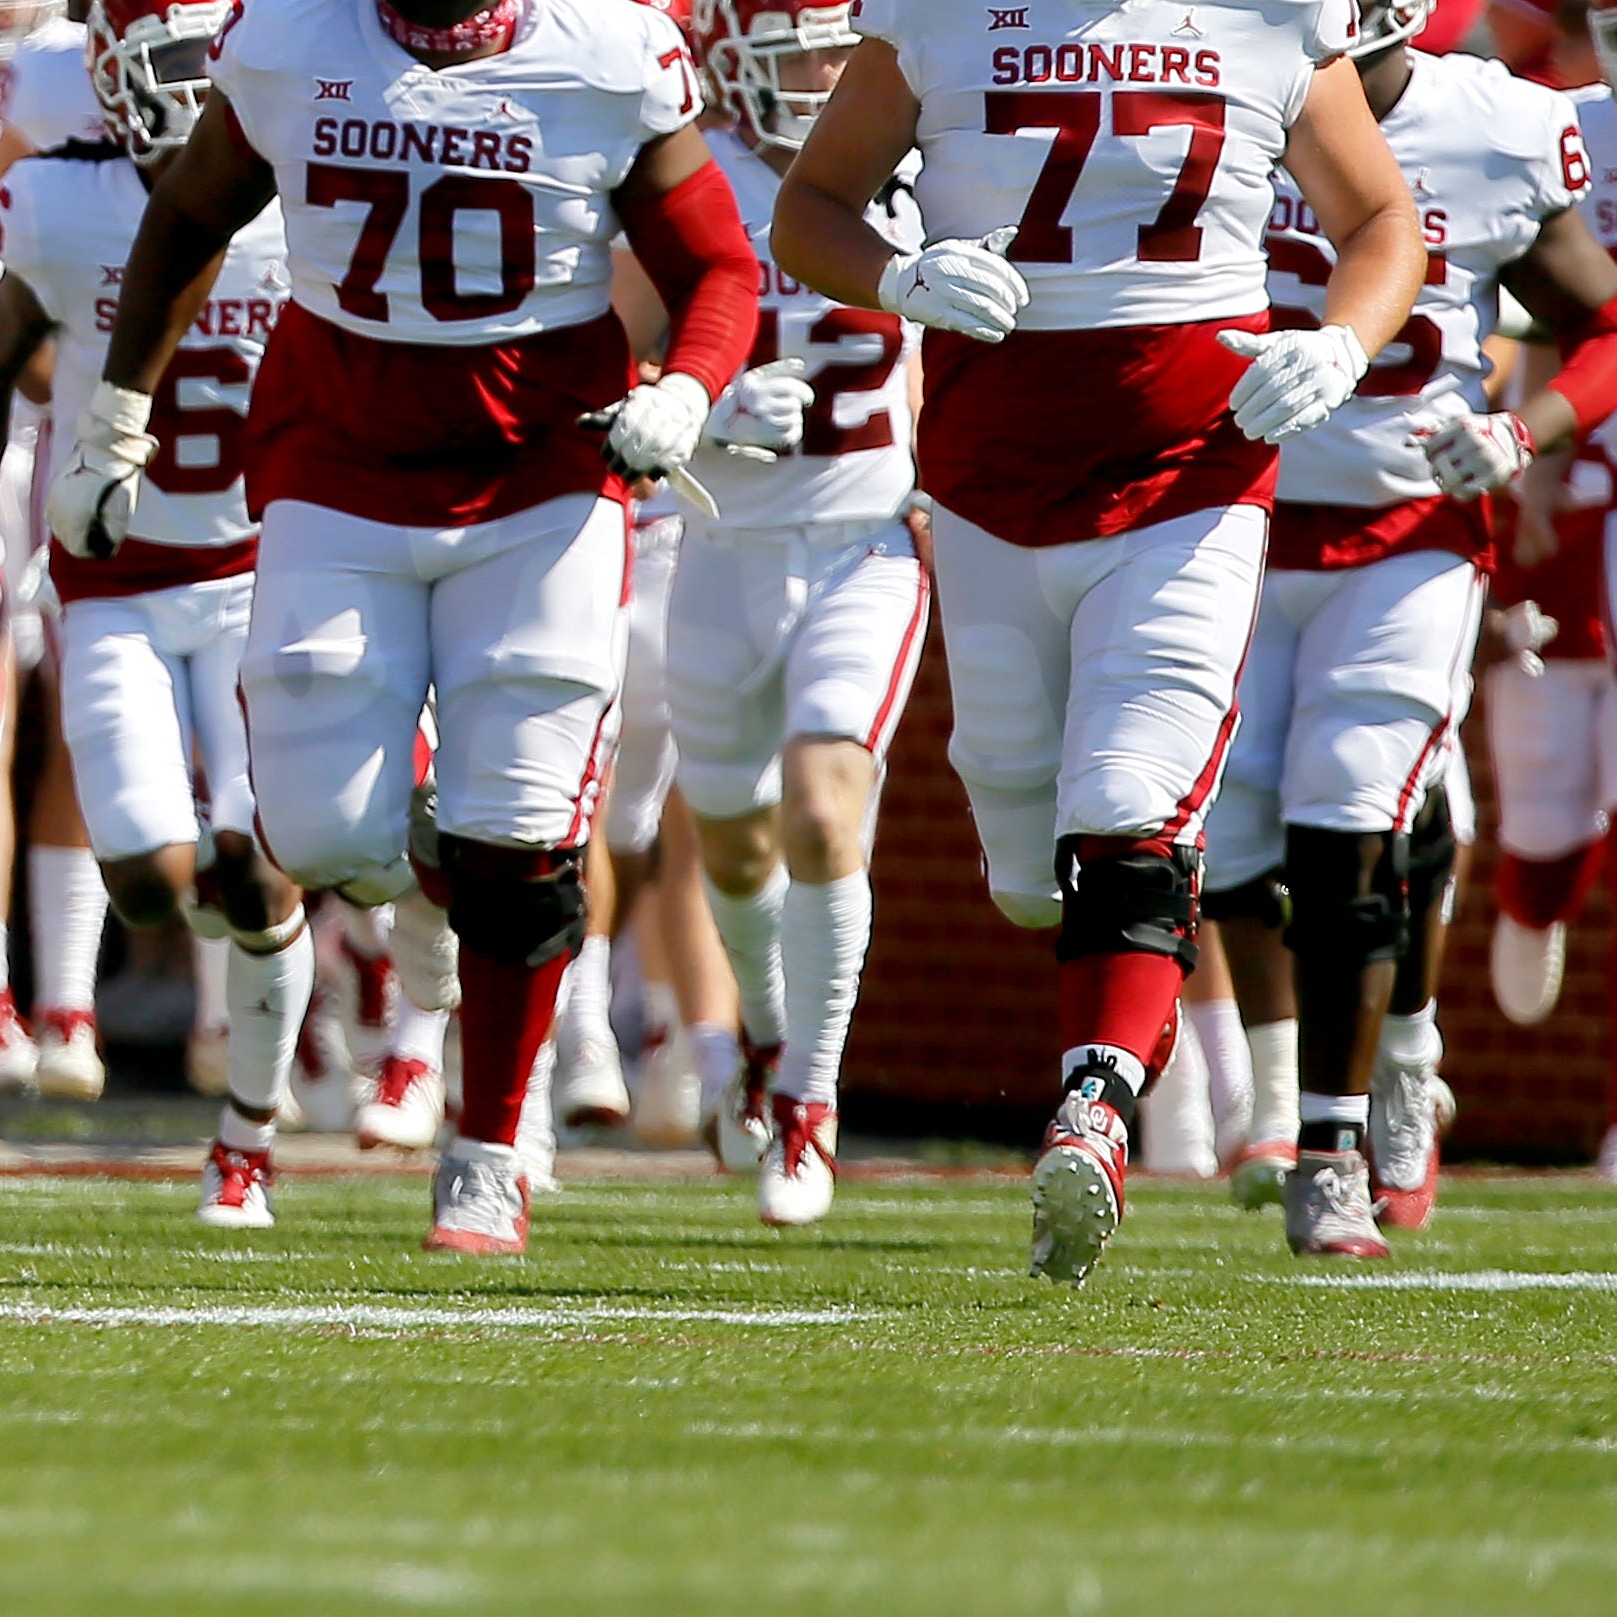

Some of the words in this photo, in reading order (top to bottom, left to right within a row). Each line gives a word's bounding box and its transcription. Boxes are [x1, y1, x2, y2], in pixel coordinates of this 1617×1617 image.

[987, 7, 1030, 31] XII
[992, 43, 1222, 87] SOONERS
[314, 79, 354, 102] XII
[313, 117, 534, 173] SOONERS
[983, 90, 1227, 264] 77
[305, 161, 537, 323] 70
